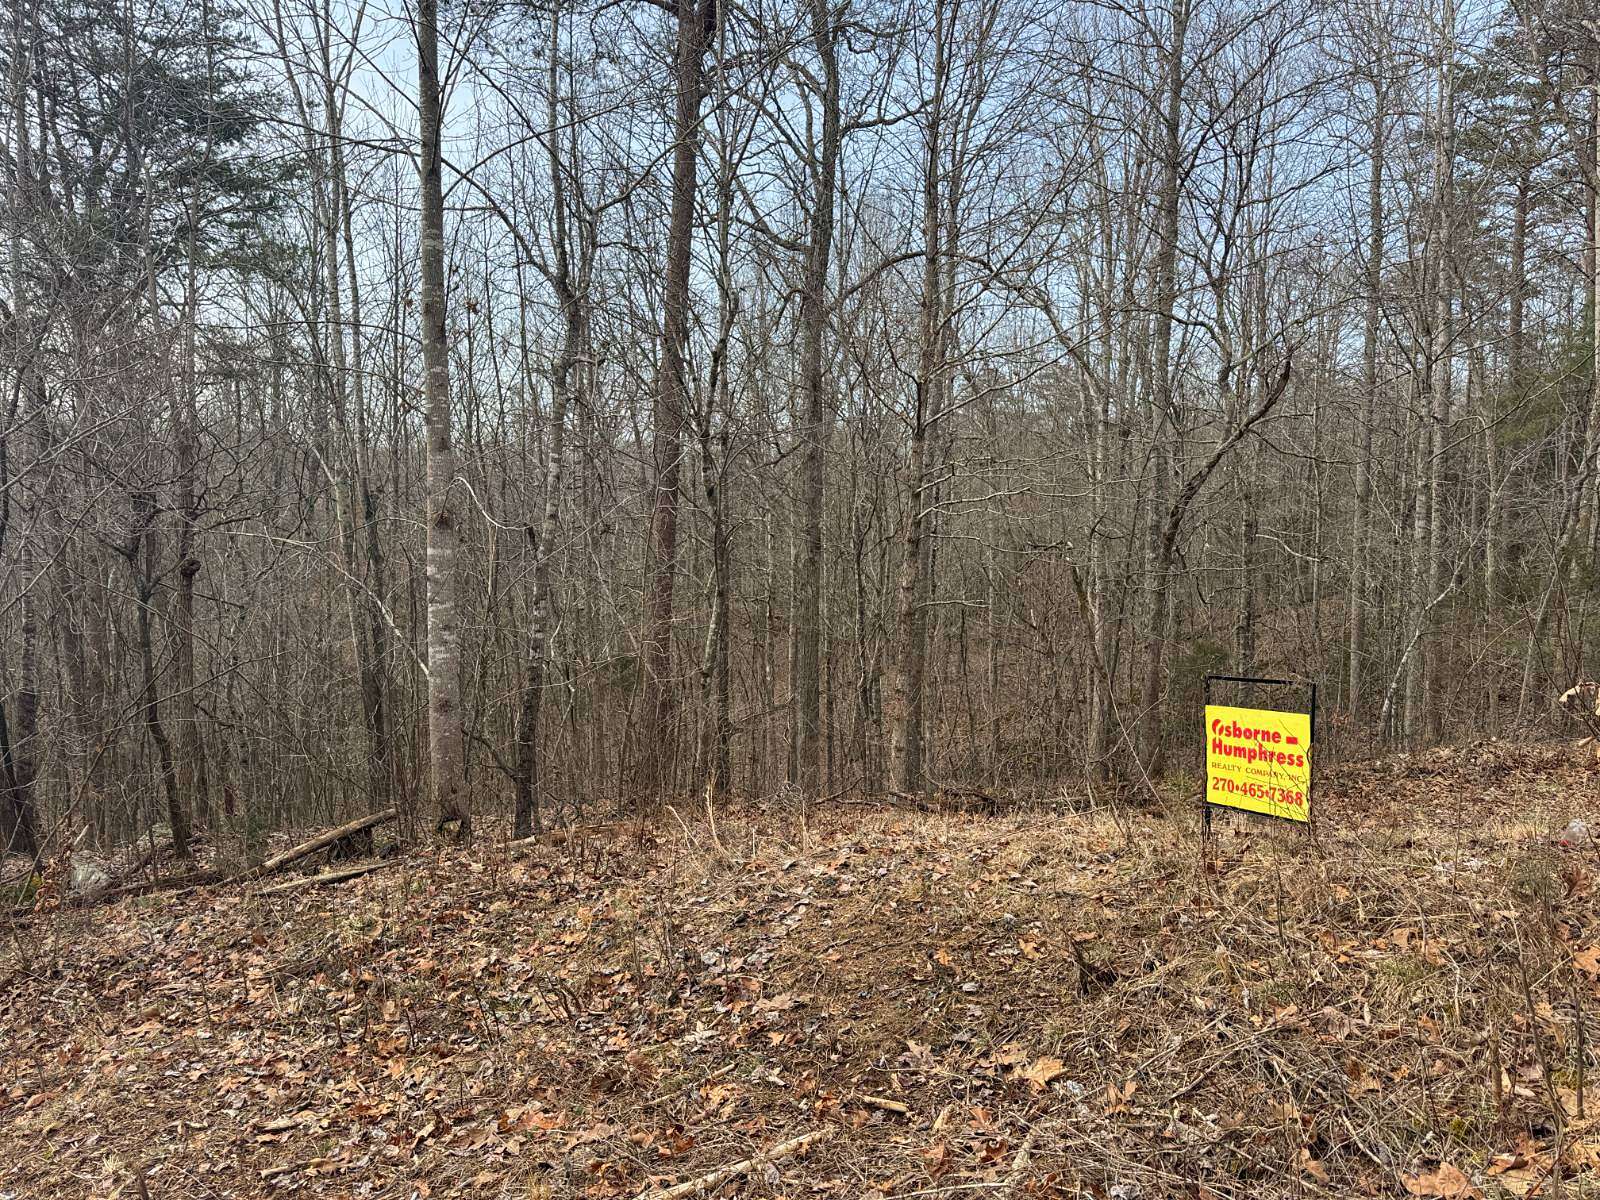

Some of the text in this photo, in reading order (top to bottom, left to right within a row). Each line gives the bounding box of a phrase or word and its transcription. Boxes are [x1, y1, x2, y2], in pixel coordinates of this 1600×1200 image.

[1212, 719, 1281, 743] Osborne
[1212, 737, 1304, 767] Humphress
[1211, 762, 1242, 772] REALTY
